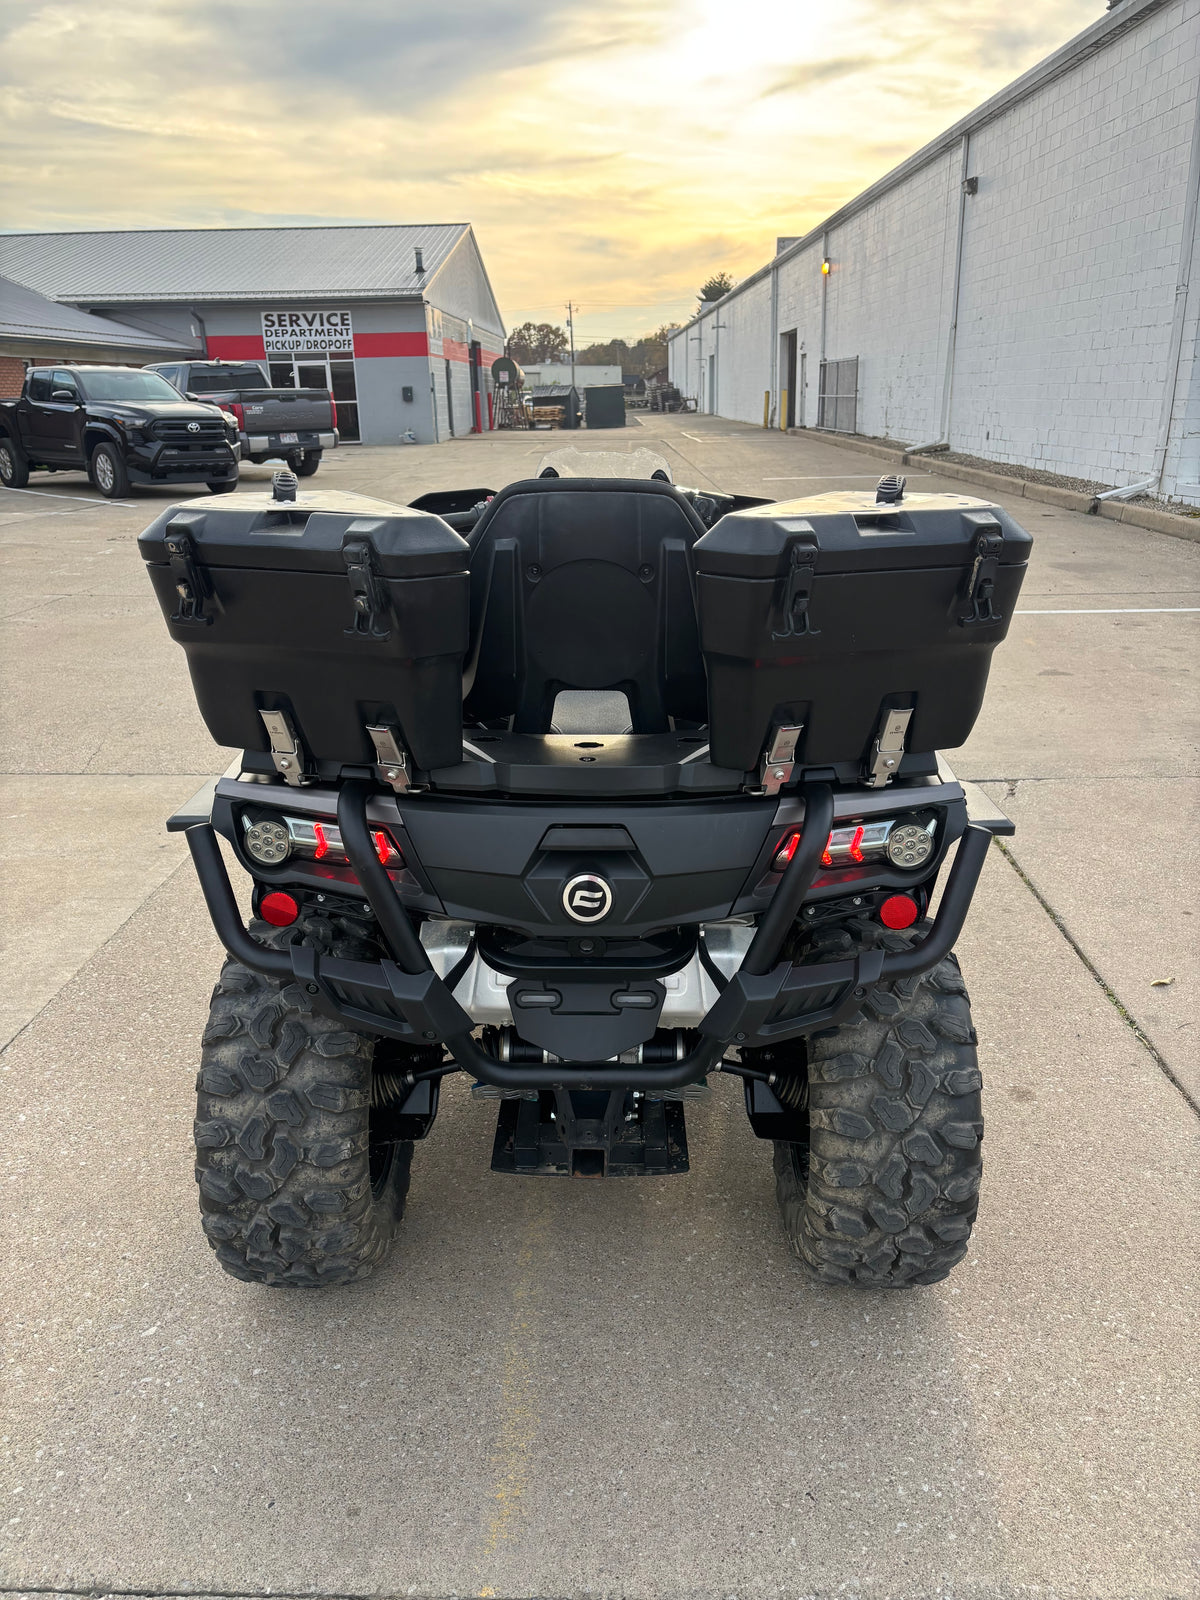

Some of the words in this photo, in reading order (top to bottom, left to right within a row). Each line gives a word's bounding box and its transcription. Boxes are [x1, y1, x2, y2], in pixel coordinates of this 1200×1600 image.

[264, 312, 350, 328] SERVICE
[265, 328, 350, 338] DEPARTMENT
[265, 339, 352, 350] PICKUP/DROPOFF
